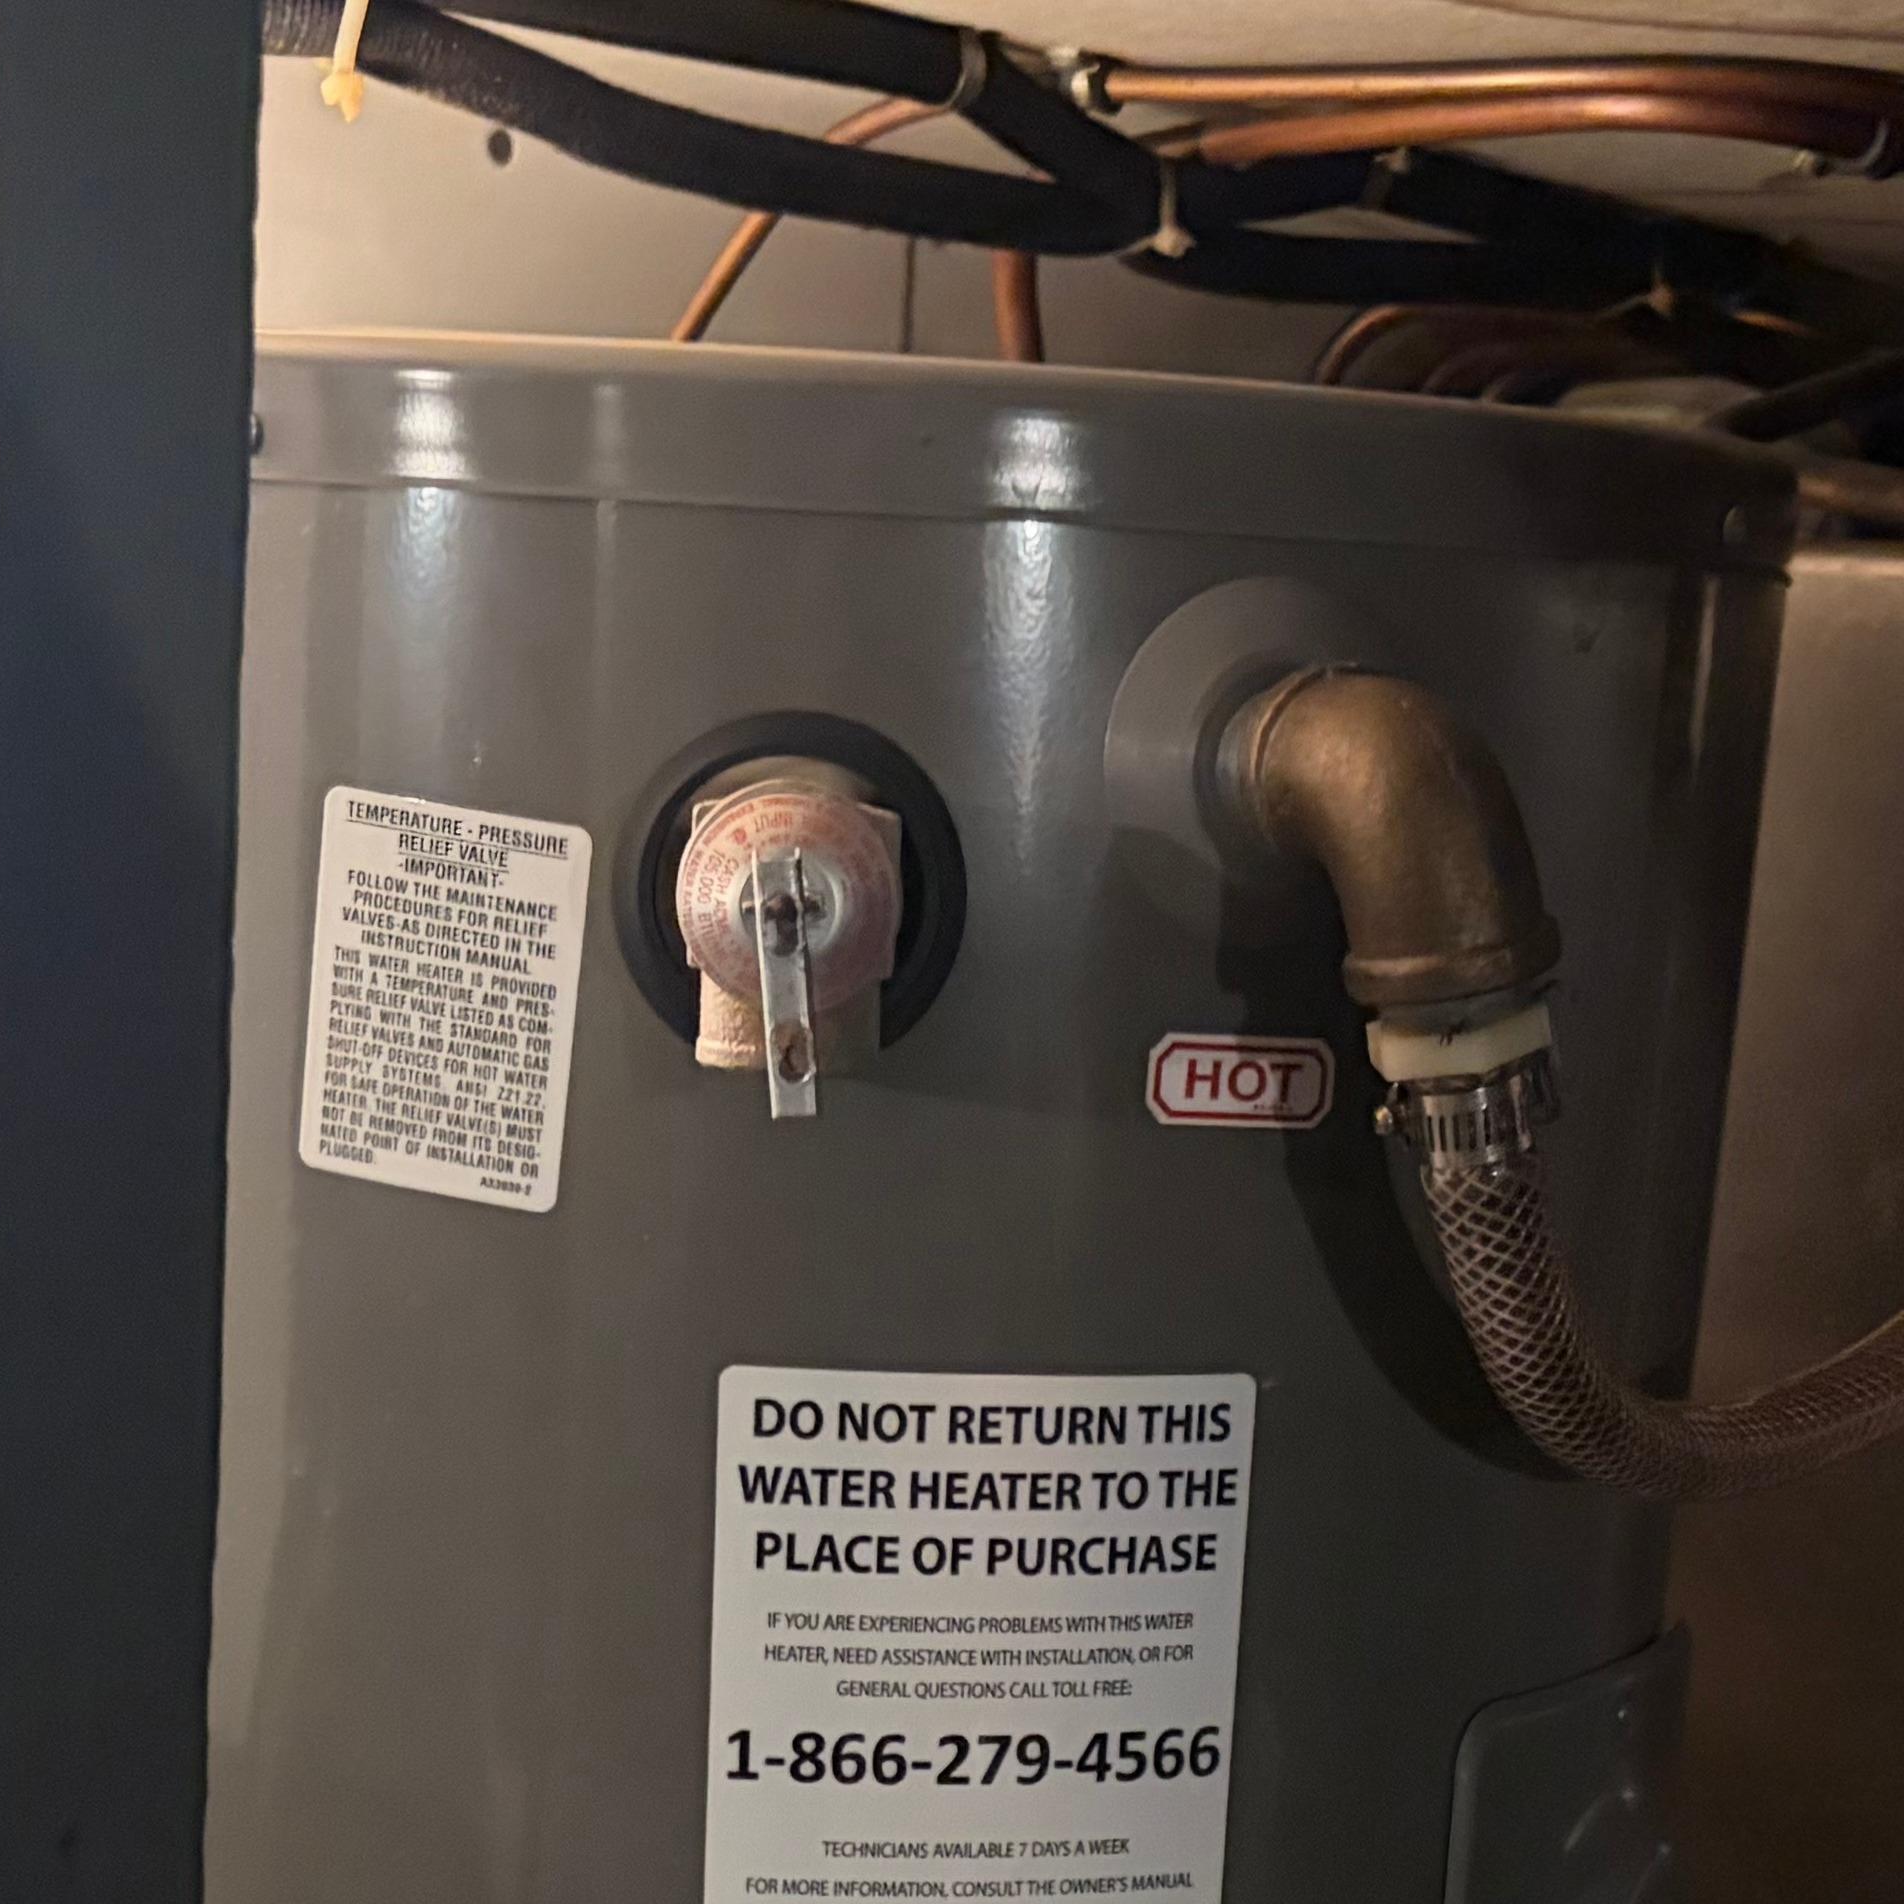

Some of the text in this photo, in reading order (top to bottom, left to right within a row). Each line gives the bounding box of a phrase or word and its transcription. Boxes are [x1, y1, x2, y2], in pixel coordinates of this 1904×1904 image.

[348, 802, 462, 834] TEMPERATURE
[478, 825, 567, 853] PRESSURE
[398, 833, 507, 866] RELIEF VALVE
[347, 870, 556, 919] FOLLOW THE MAINTENANCE
[398, 857, 503, 887] -IMPORTANT-
[353, 890, 547, 938] PROCEDURES FOR RELIEF
[360, 930, 530, 973] INSTRUCTION MANUAL
[424, 923, 500, 949] DIRECTED
[504, 936, 521, 953] IN
[527, 940, 555, 959] THE
[332, 964, 554, 1018] WITH A TEMPERATURE AND PRES-
[334, 945, 556, 999] THIS WATER HEATER IS PROVIDED
[329, 1000, 551, 1051] PLYING WITH THE STANDARD FOR
[365, 988, 406, 1008] RELIEF
[409, 997, 445, 1016] VALVE
[450, 1004, 494, 1024] LISTED
[497, 1012, 514, 1028] AS
[517, 1016, 552, 1035] COM-
[328, 1017, 549, 1071] RELIEF VALVES AND AUTOMATIC GAS
[387, 1047, 438, 1069] DEVICES
[443, 1057, 468, 1075] FOR
[472, 1062, 498, 1080] HOT
[503, 1069, 548, 1089] WATER
[1184, 1058, 1303, 1103] HOT
[753, 1398, 1230, 1444] DO NOT RETURN THIS
[738, 1465, 1237, 1510] WATER HEATER TO THE
[755, 1532, 1217, 1575] PLACE OF PURCHASE
[767, 1611, 1193, 1633] IF YOU ARE EXPERIENCING PROBLEMS WITH THIS WATER
[763, 1644, 1193, 1665] HEATER, NEED ASSISTANCE WITH INSTALLATION, OR FOR
[835, 1680, 911, 1697] GENERAL
[913, 1681, 1006, 1698] QUESTIONS
[1008, 1681, 1048, 1698] CALL
[1051, 1680, 1089, 1697] TOLL
[726, 1727, 1220, 1784] 1-866-279-4566
[821, 1838, 1129, 1858] TECHNICIANS AVAILABLE 7 DAYS A WEEK
[745, 1877, 778, 1894] FOR
[781, 1879, 829, 1895] MORE
[951, 1880, 1024, 1897] CONSULT
[1025, 1879, 1056, 1895] THE
[1130, 1872, 1192, 1890] MANUAL
